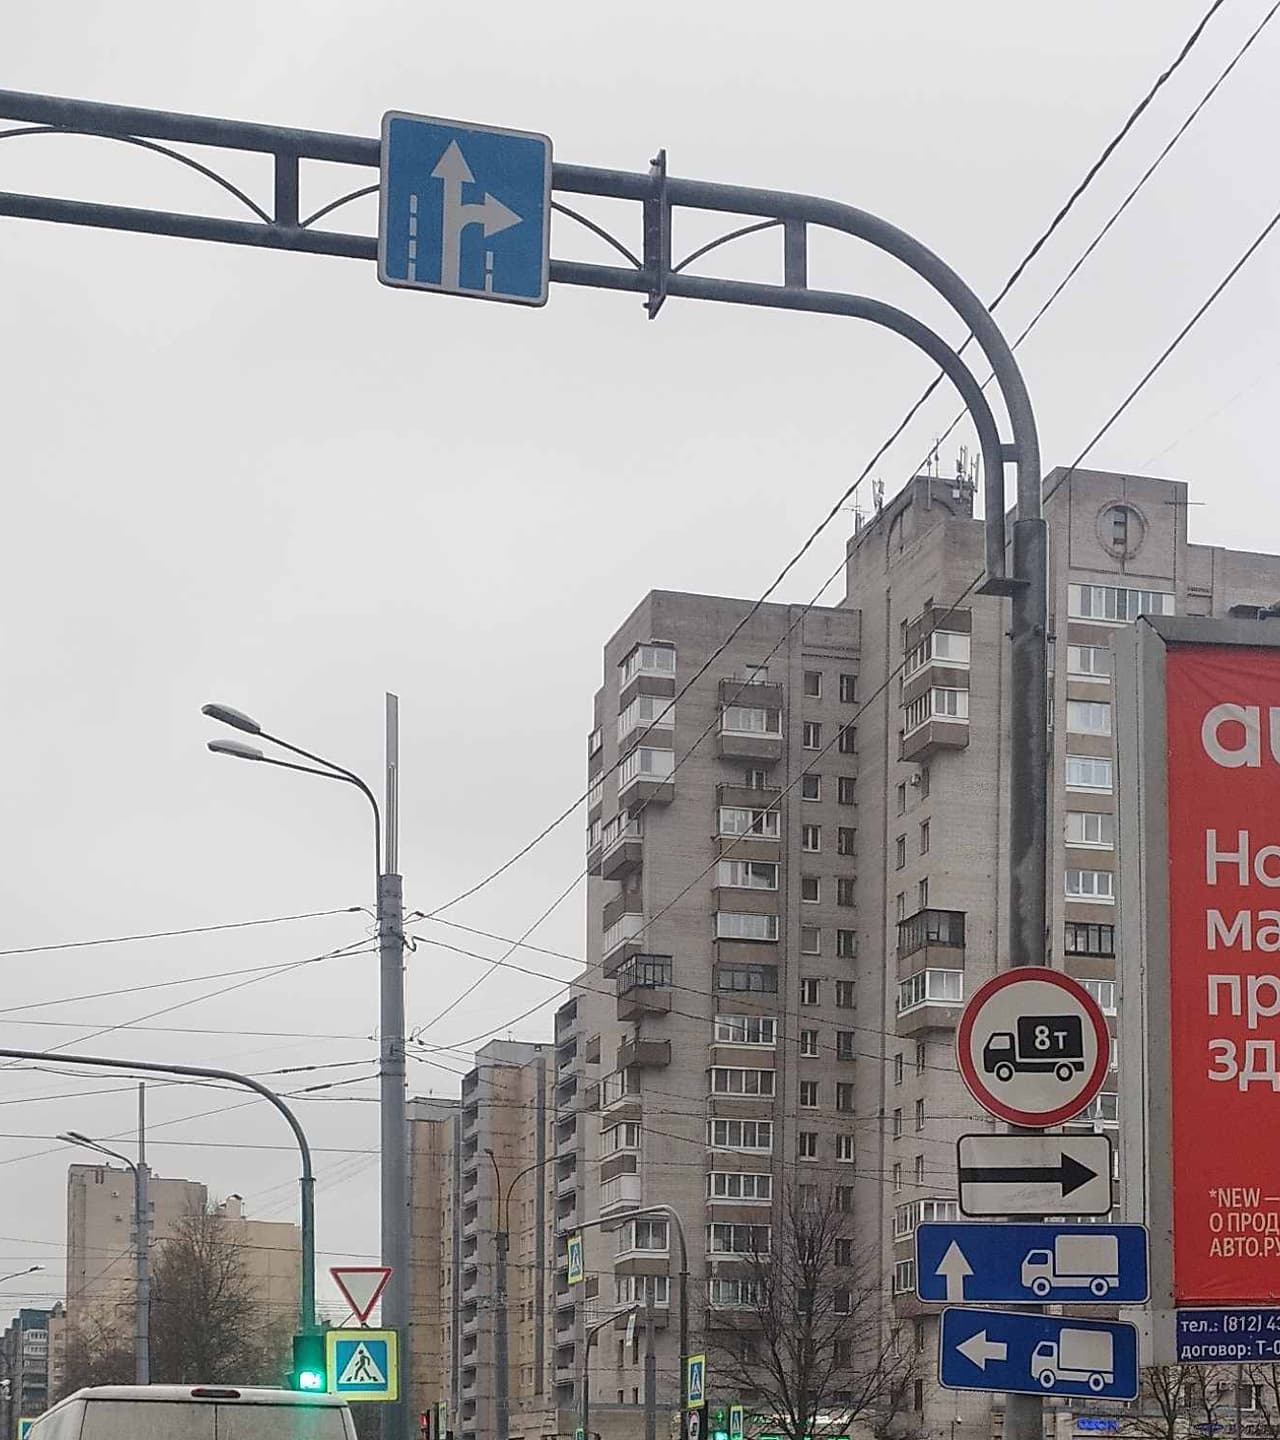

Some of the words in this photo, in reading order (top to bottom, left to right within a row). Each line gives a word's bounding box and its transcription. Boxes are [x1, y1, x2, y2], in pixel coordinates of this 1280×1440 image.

[1209, 1212, 1224, 1232] О
[1223, 1314, 1262, 1333] (812)
[1181, 1343, 1251, 1360] договор:
